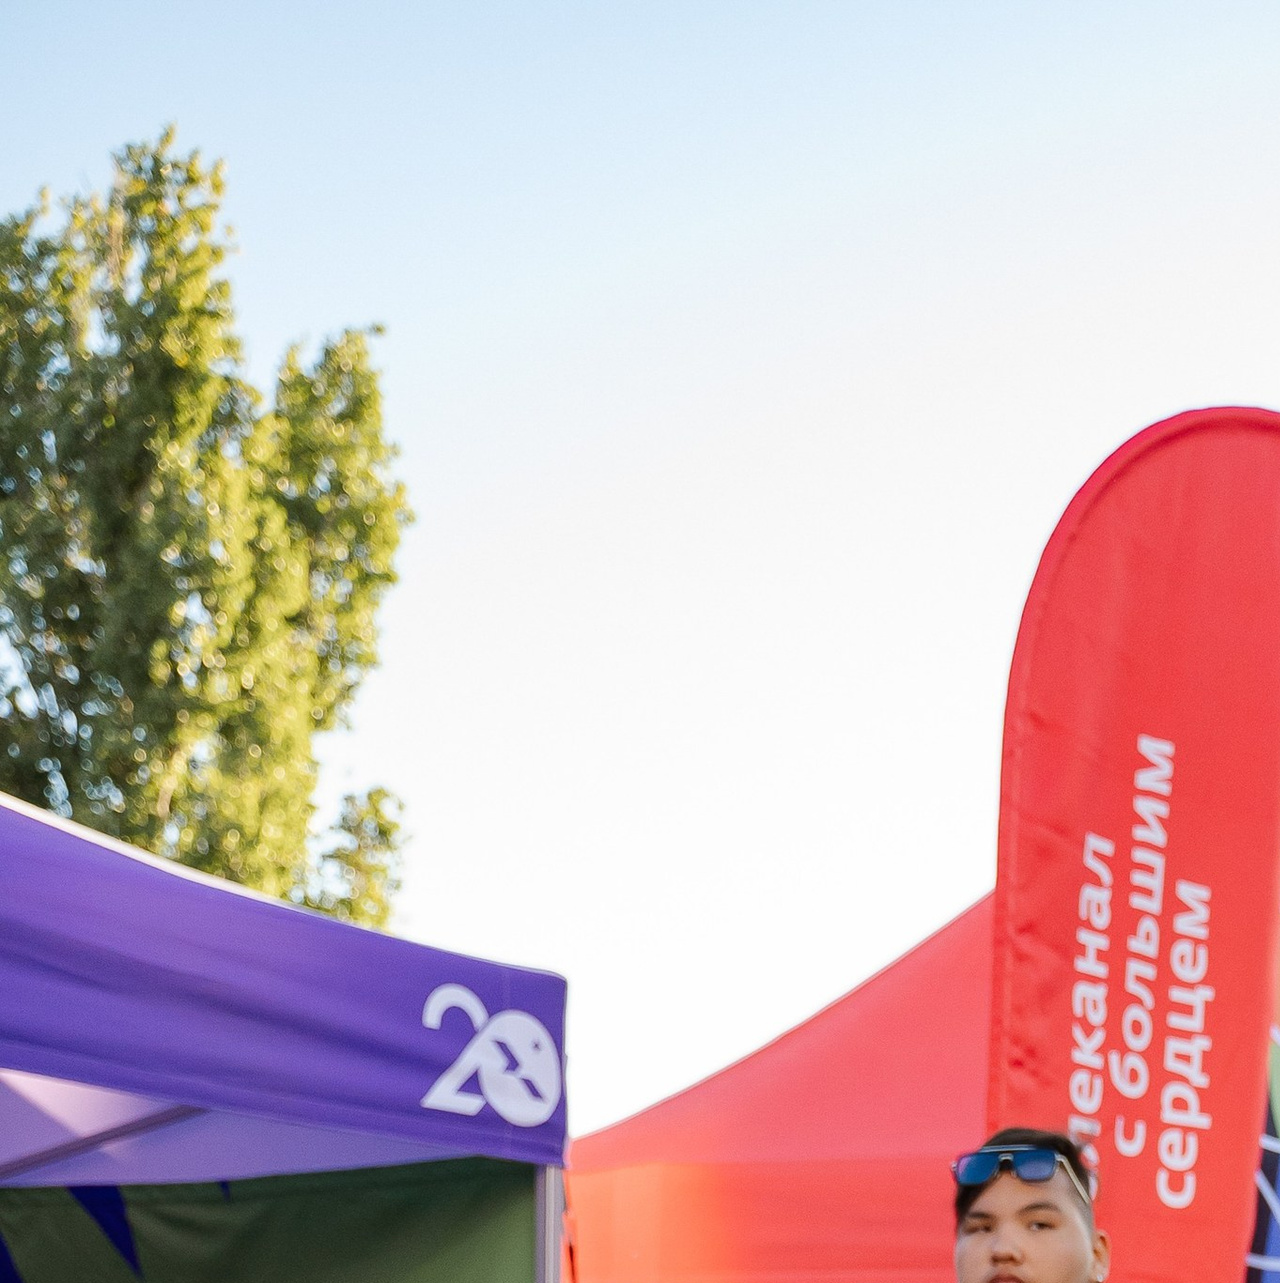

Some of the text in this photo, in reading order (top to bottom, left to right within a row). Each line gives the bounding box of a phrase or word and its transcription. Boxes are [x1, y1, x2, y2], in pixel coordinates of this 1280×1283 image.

[1107, 732, 1176, 1158] с большим
[1155, 878, 1217, 1210] сердцем
